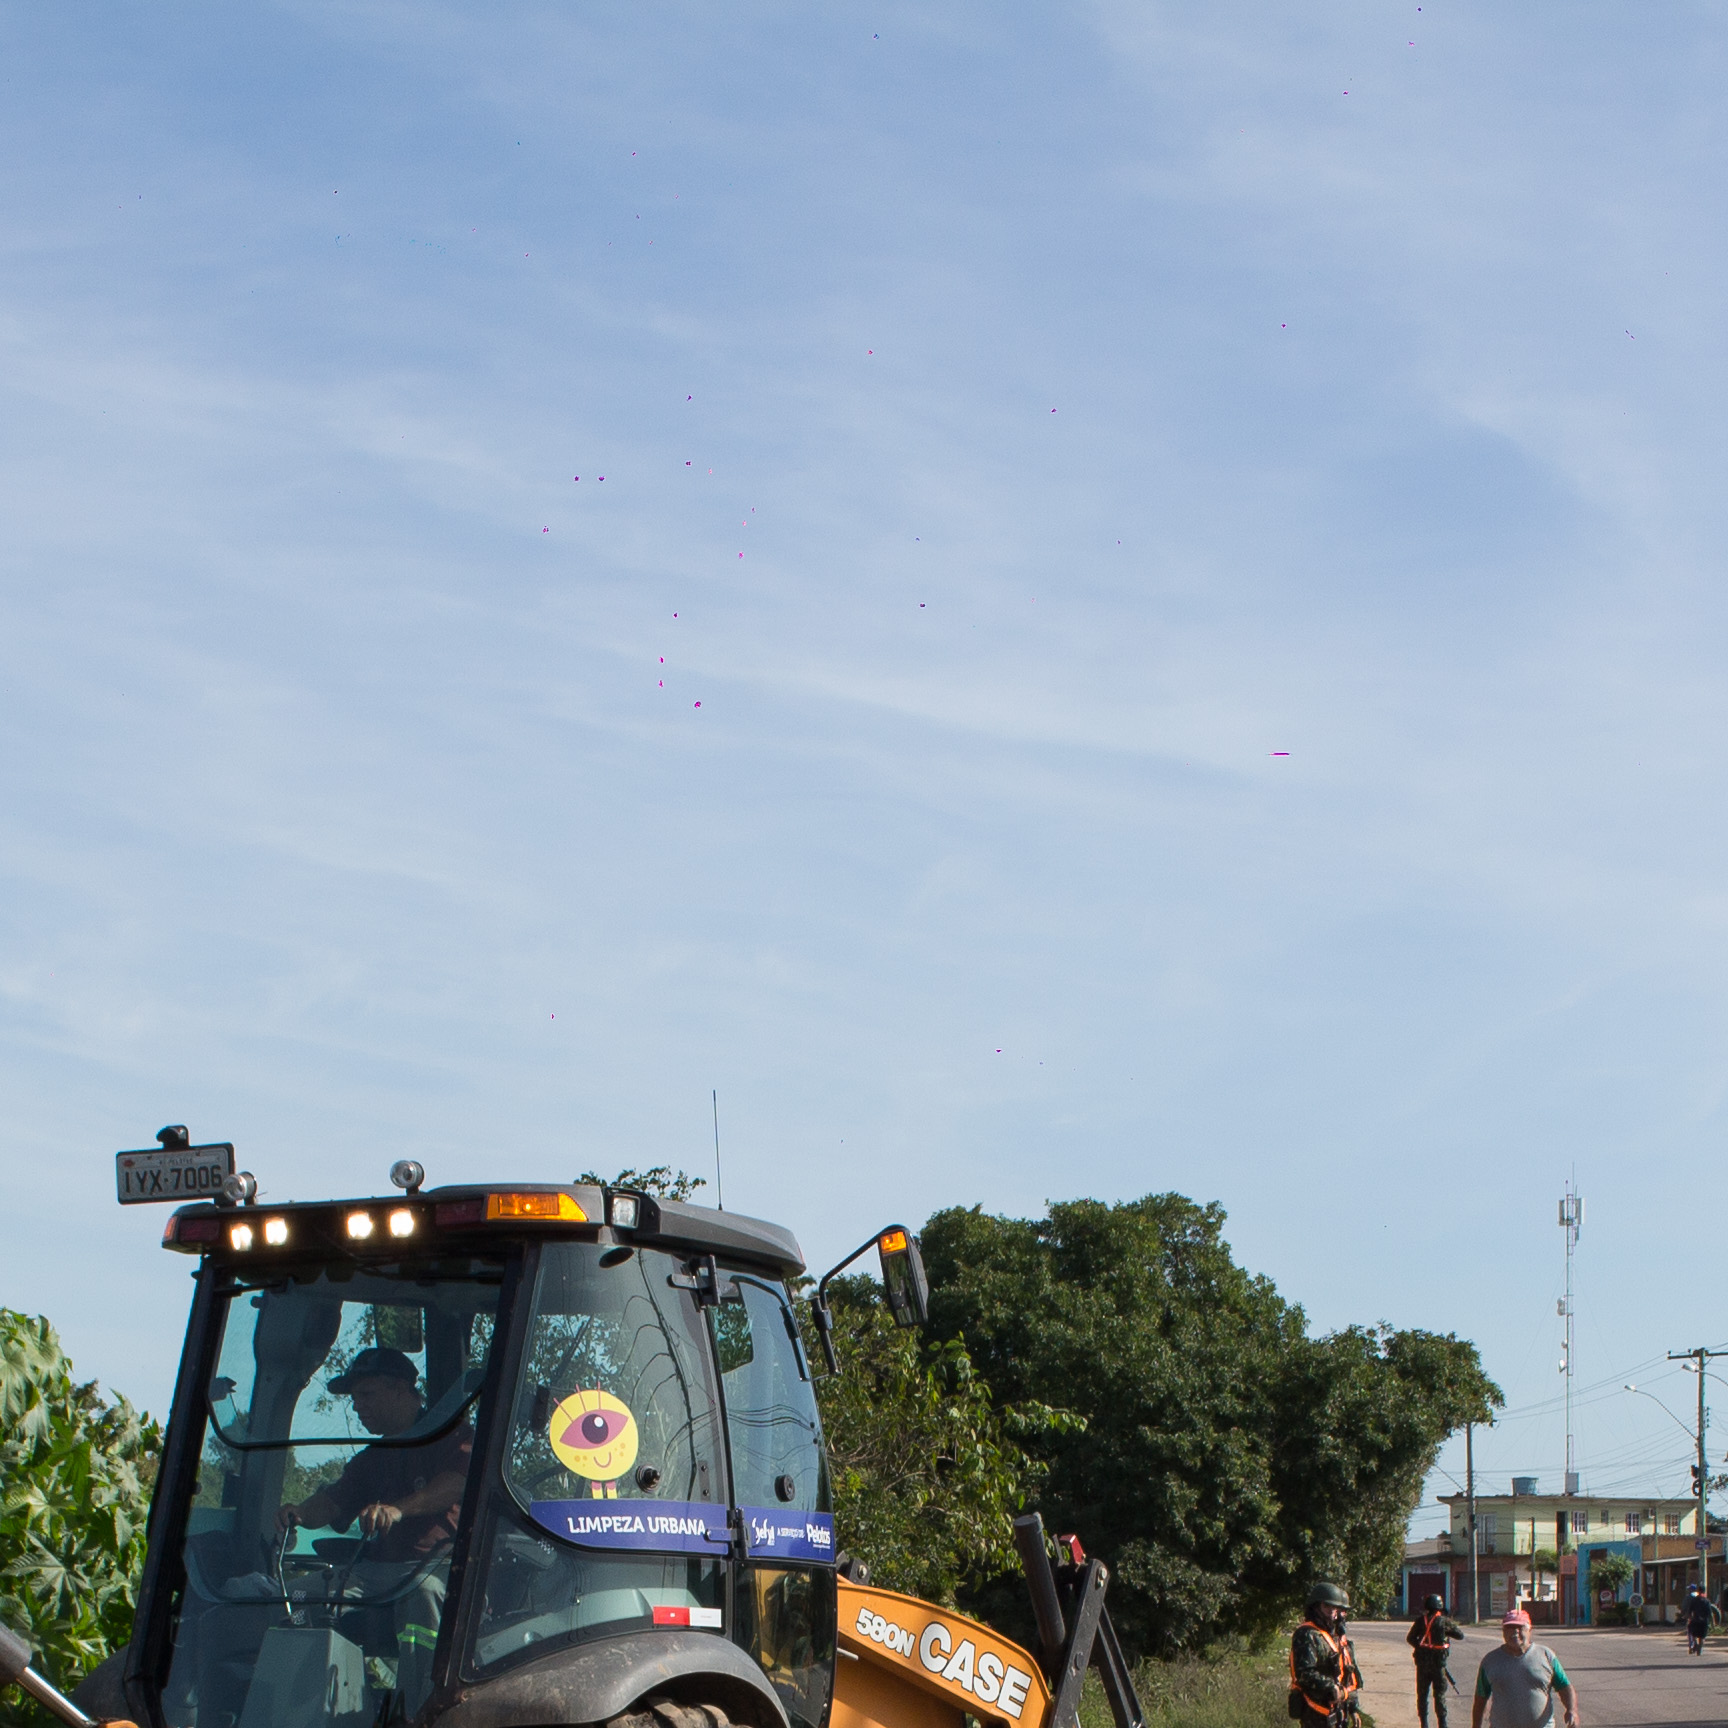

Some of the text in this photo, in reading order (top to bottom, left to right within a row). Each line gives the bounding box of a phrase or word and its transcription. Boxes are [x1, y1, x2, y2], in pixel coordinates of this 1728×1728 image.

[568, 1516, 706, 1536] LIMPEZA URBANA
[806, 1523, 831, 1545] Pelotas
[856, 1606, 1032, 1720] 580N CASE
